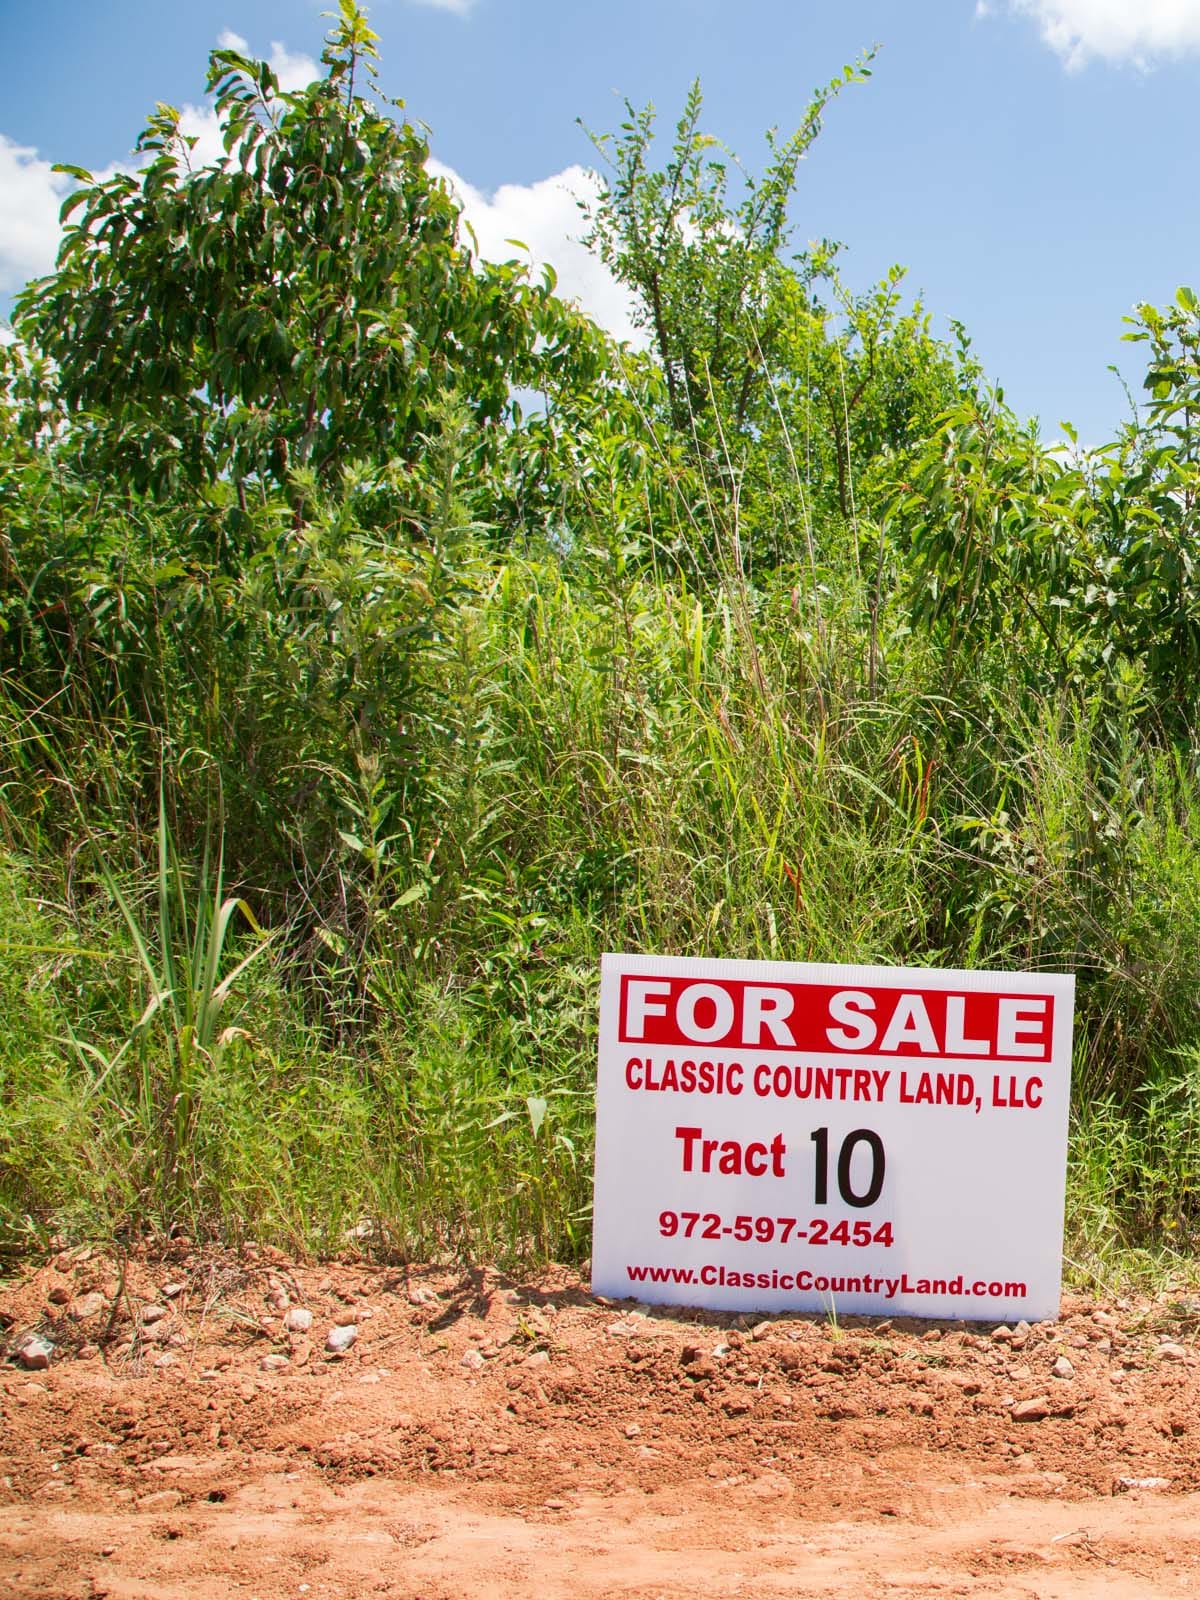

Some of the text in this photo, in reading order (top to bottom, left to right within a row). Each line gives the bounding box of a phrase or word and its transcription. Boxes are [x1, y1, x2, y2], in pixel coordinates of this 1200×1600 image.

[625, 980, 1047, 1057] FOR SALE
[625, 1057, 1044, 1115] CLASSIC COUNTRY LAND, LLC
[674, 1126, 886, 1209] Tract 10
[658, 1210, 895, 1248] 972-597-2454
[626, 1264, 1027, 1300] www.ClassicCountryLand.com
